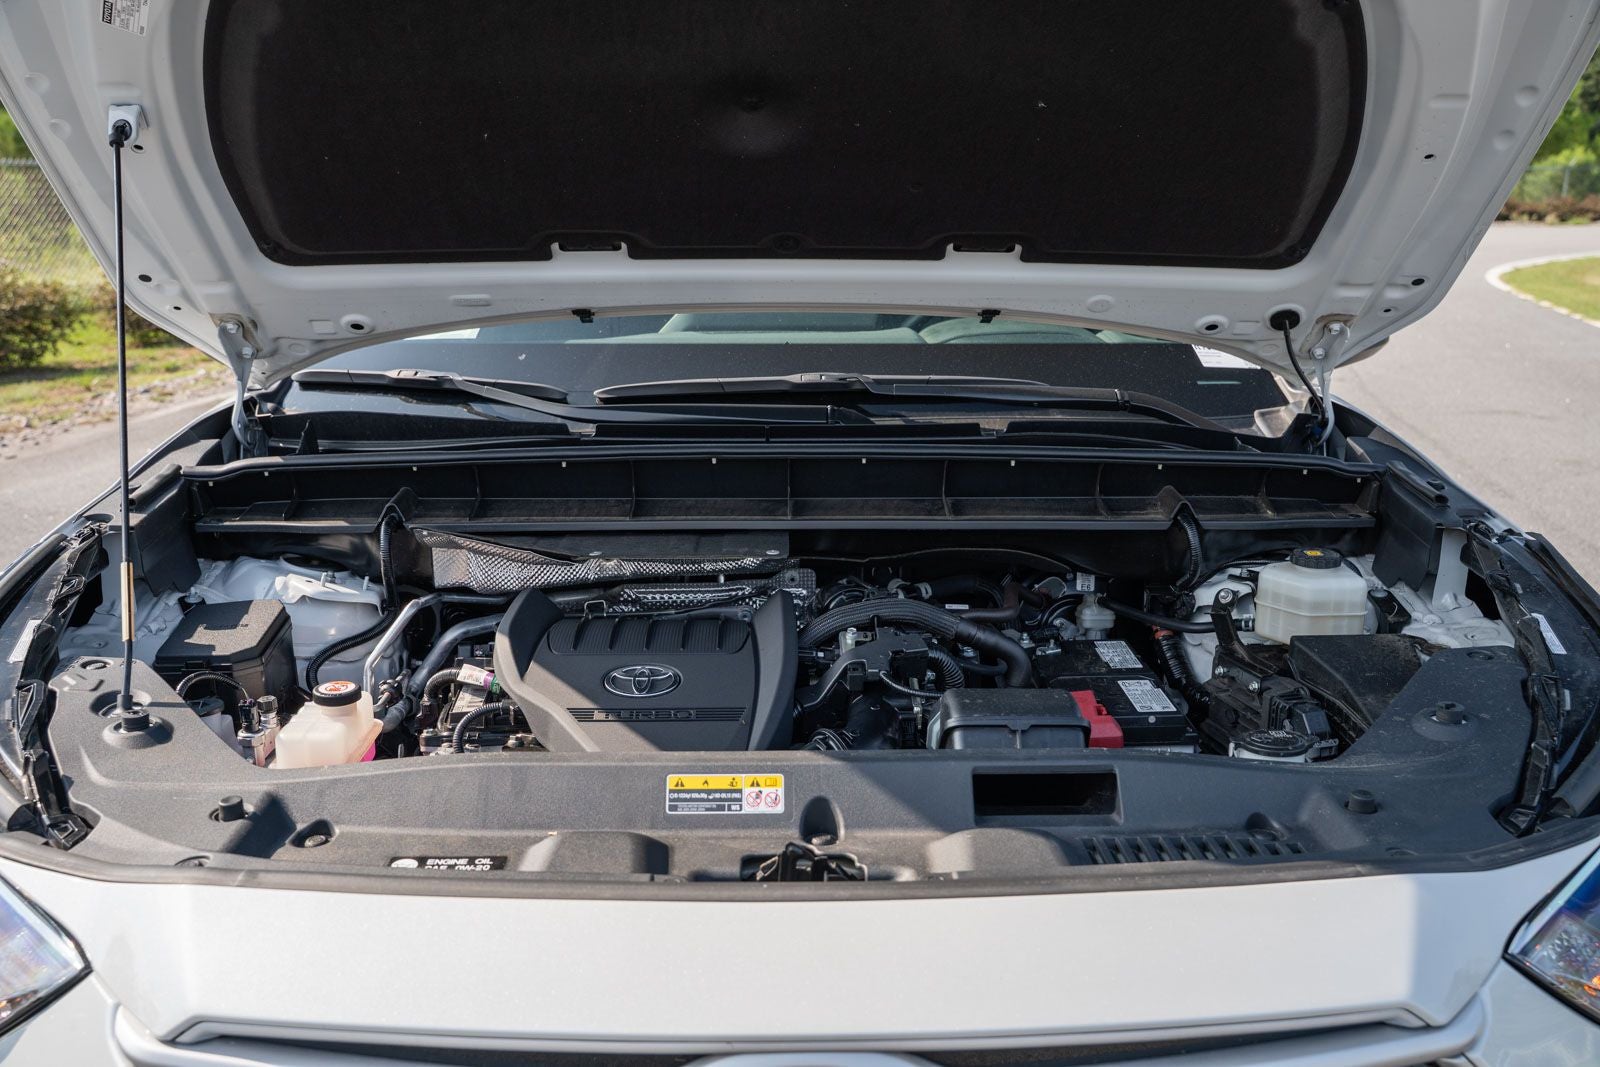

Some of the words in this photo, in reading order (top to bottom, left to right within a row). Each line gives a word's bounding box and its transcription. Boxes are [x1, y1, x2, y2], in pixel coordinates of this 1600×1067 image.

[103, 1, 112, 23] TOYOTA
[1081, 583, 1091, 591] E6
[598, 709, 694, 720] TURBO
